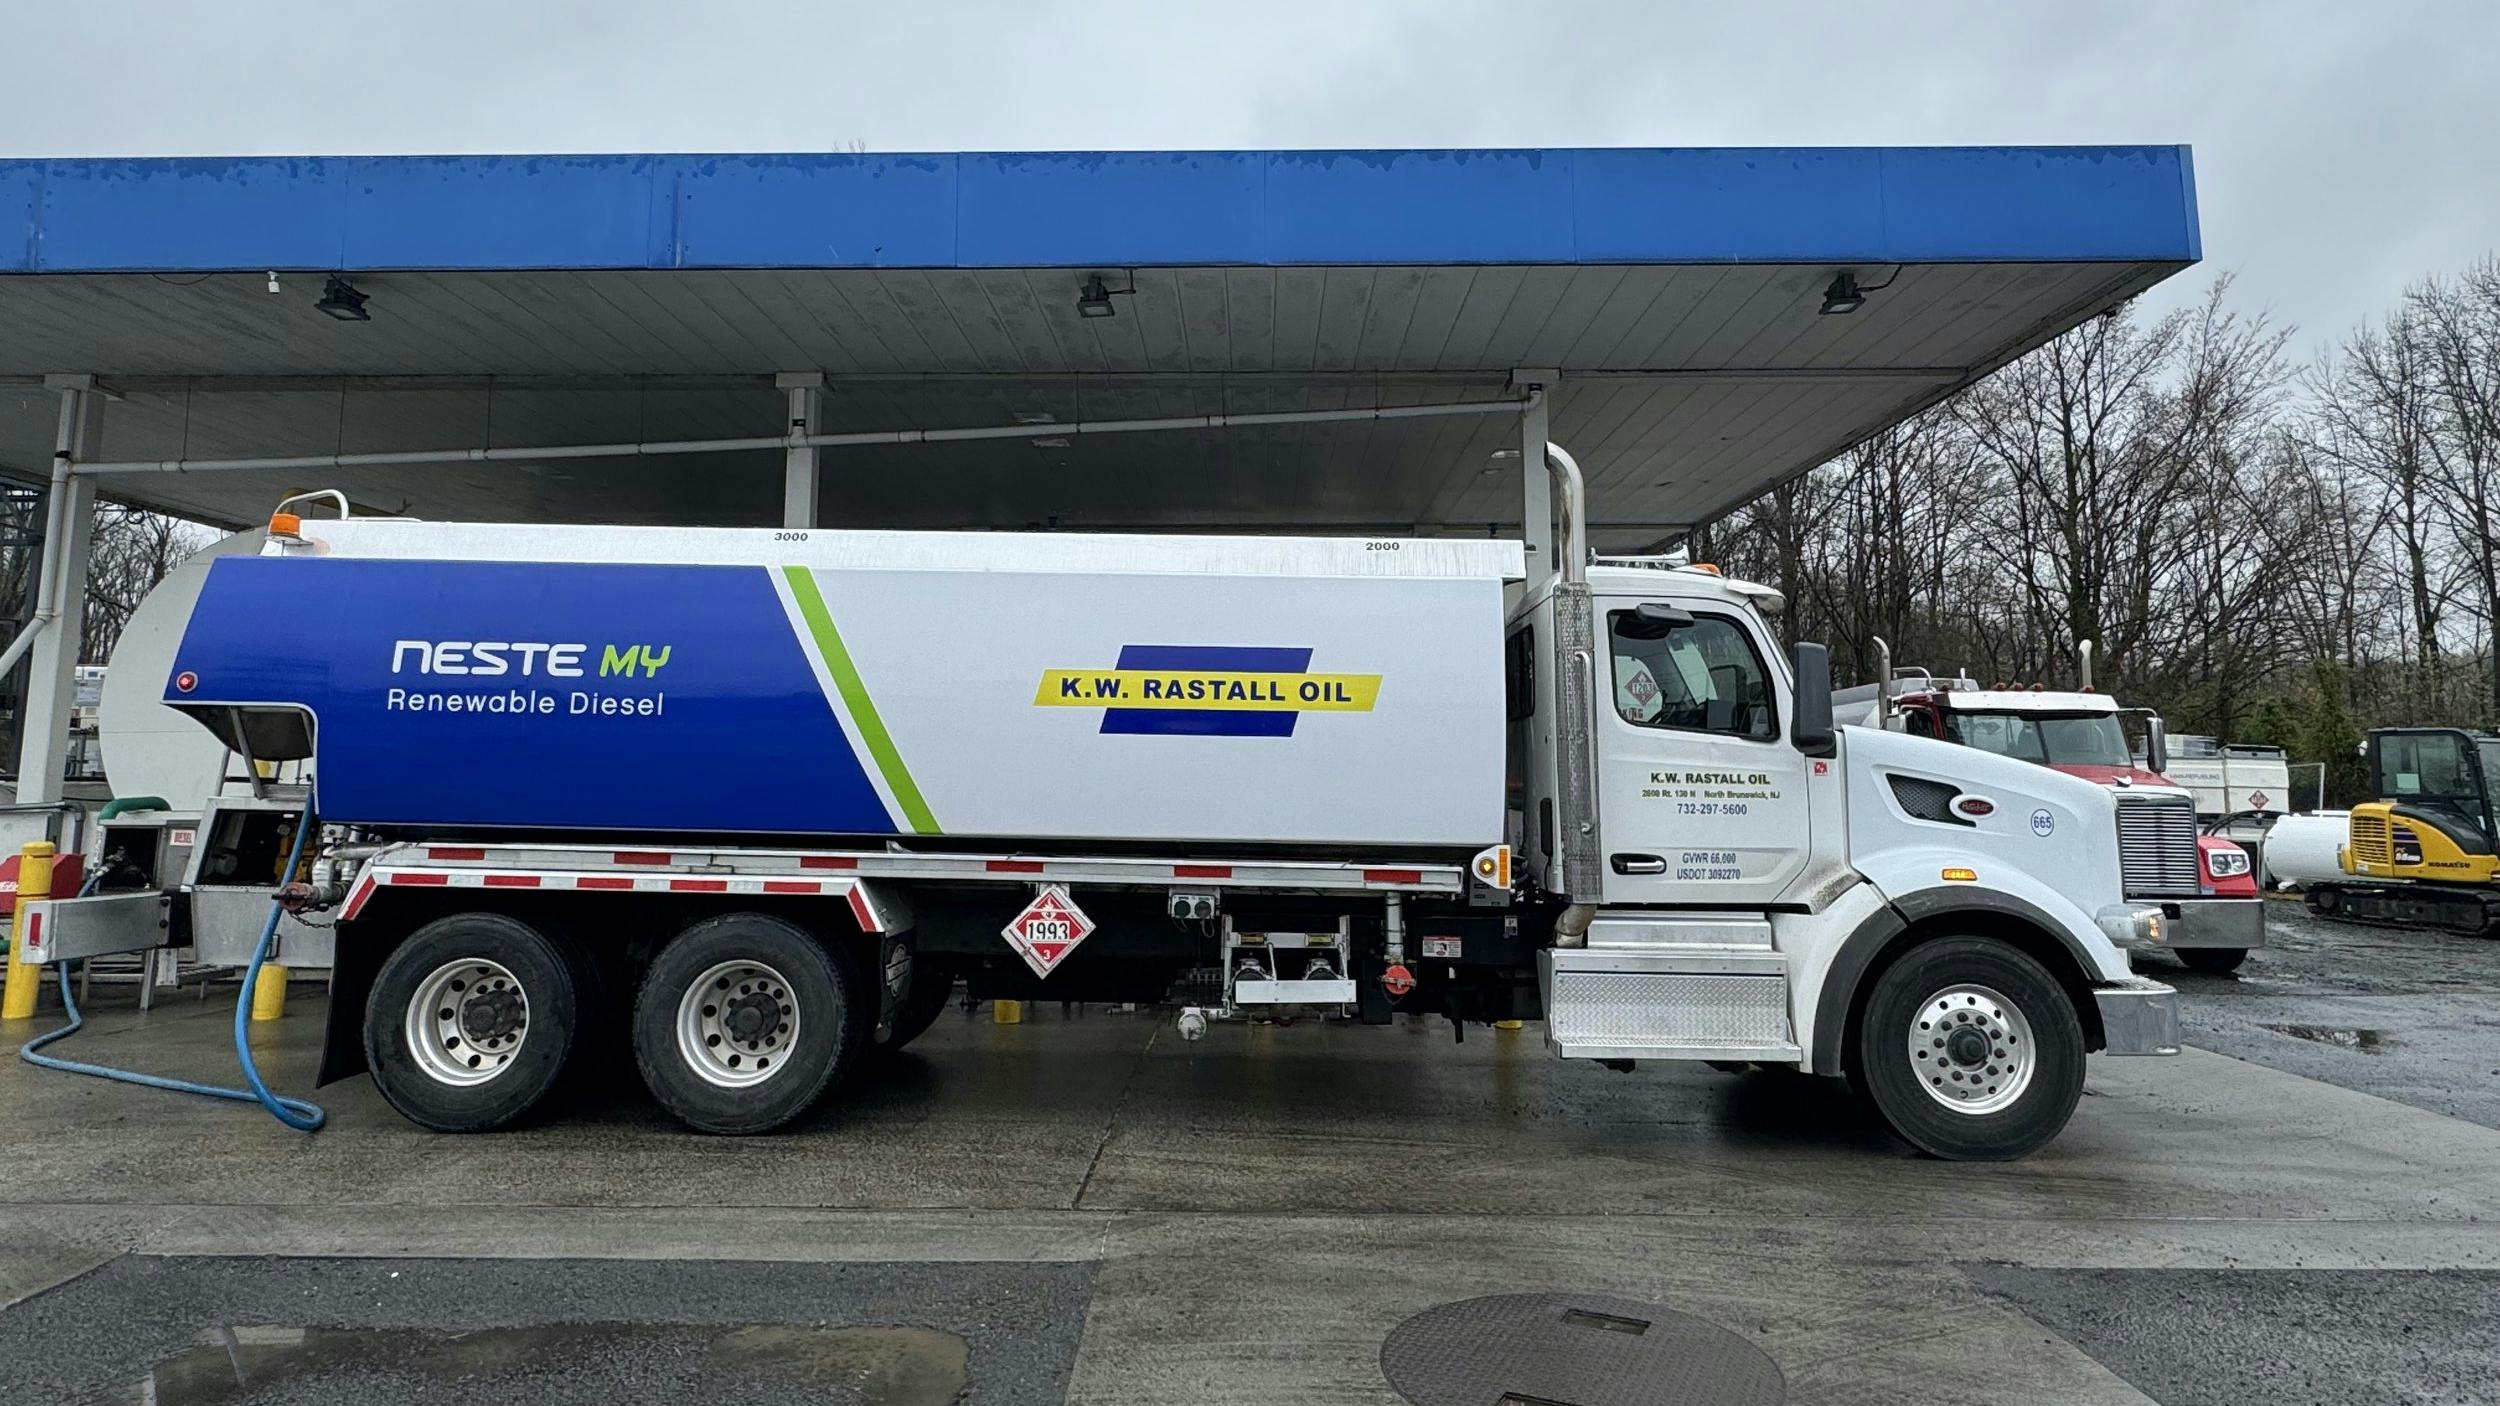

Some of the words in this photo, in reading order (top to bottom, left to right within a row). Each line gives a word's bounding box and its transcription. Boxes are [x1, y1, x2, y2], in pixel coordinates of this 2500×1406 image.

[774, 532, 808, 541] 3000
[1366, 542, 1400, 551] 2000
[391, 640, 587, 677] NESTE
[599, 645, 672, 678] MY
[1061, 677, 1130, 699] K.W.
[1143, 679, 1286, 701] RASTALL
[1299, 681, 1352, 702] OIL
[388, 688, 556, 714] Renewable
[570, 692, 664, 716] Diesel
[1650, 772, 1681, 784] K.W.
[1686, 773, 1745, 784] RASTALL
[1748, 774, 1770, 785] OIL
[1704, 790, 1725, 799] North
[1770, 791, 1780, 799] NJ
[1677, 803, 1748, 815] 732-297-5600
[2033, 815, 2052, 829] 665
[1682, 852, 1709, 864] GVWR
[1677, 868, 1707, 880] USDOT
[1028, 922, 1068, 940] 1993
[1043, 949, 1051, 960] 3
